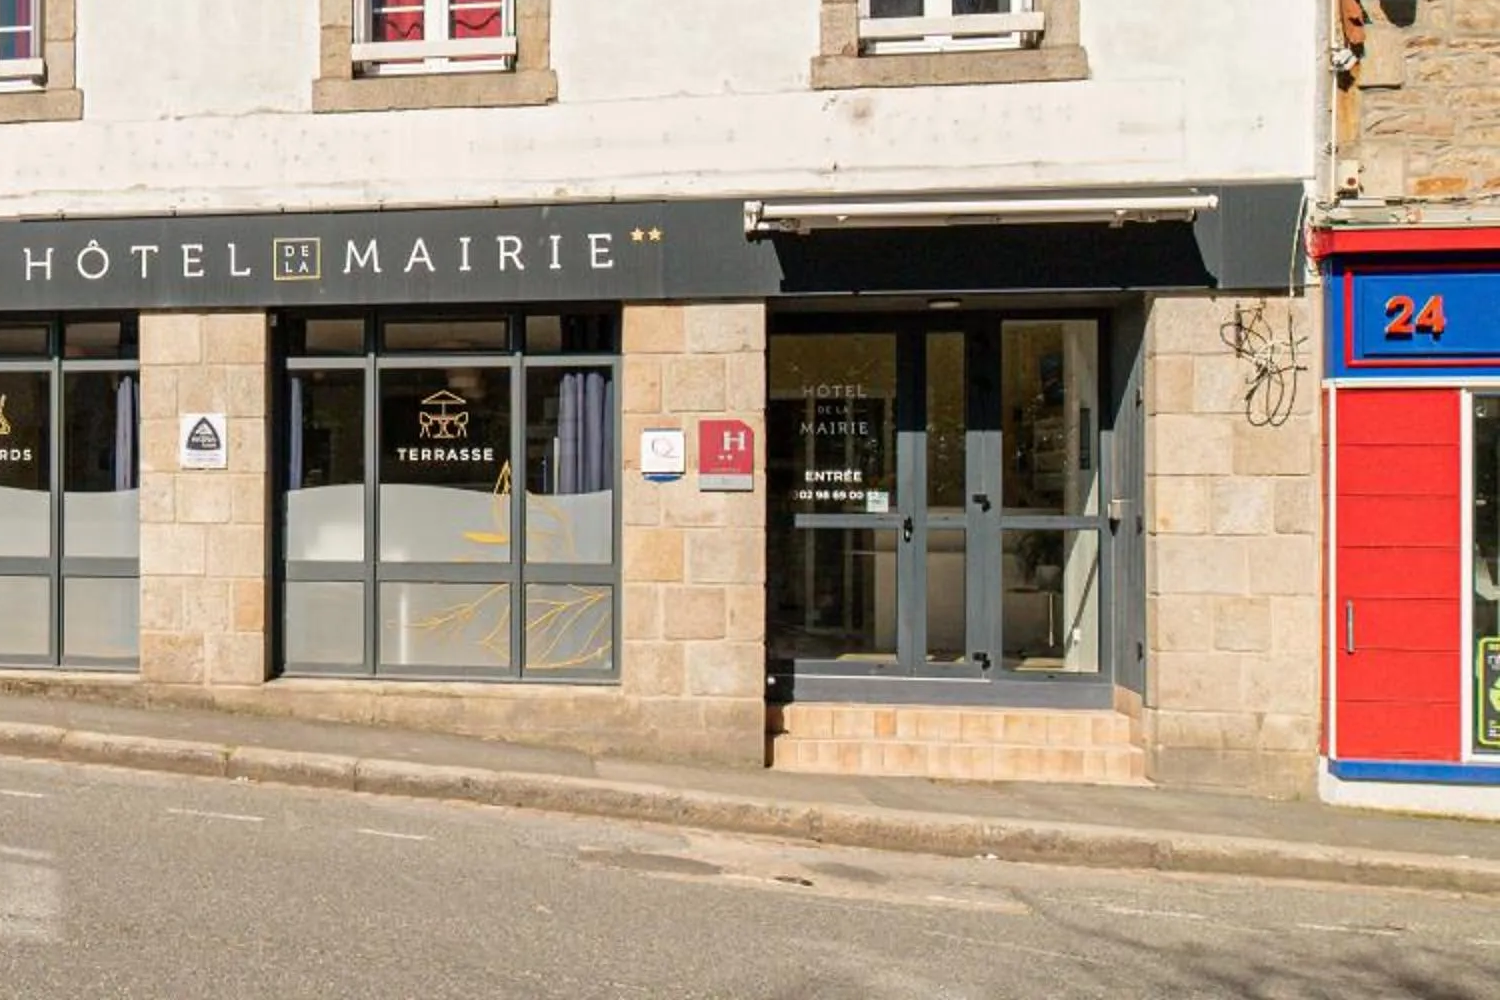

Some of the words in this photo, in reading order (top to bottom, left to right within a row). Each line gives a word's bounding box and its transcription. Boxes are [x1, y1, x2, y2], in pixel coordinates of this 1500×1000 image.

[284, 245, 309, 257] DE
[343, 233, 614, 273] MAIRIE
[23, 239, 251, 281] HÔTEL
[285, 261, 309, 273] LA
[1384, 295, 1447, 336] 24
[800, 421, 869, 435] MAIRIE
[723, 430, 745, 451] H
[397, 447, 494, 461] TERRASSE
[805, 468, 862, 482] ENTRÉE
